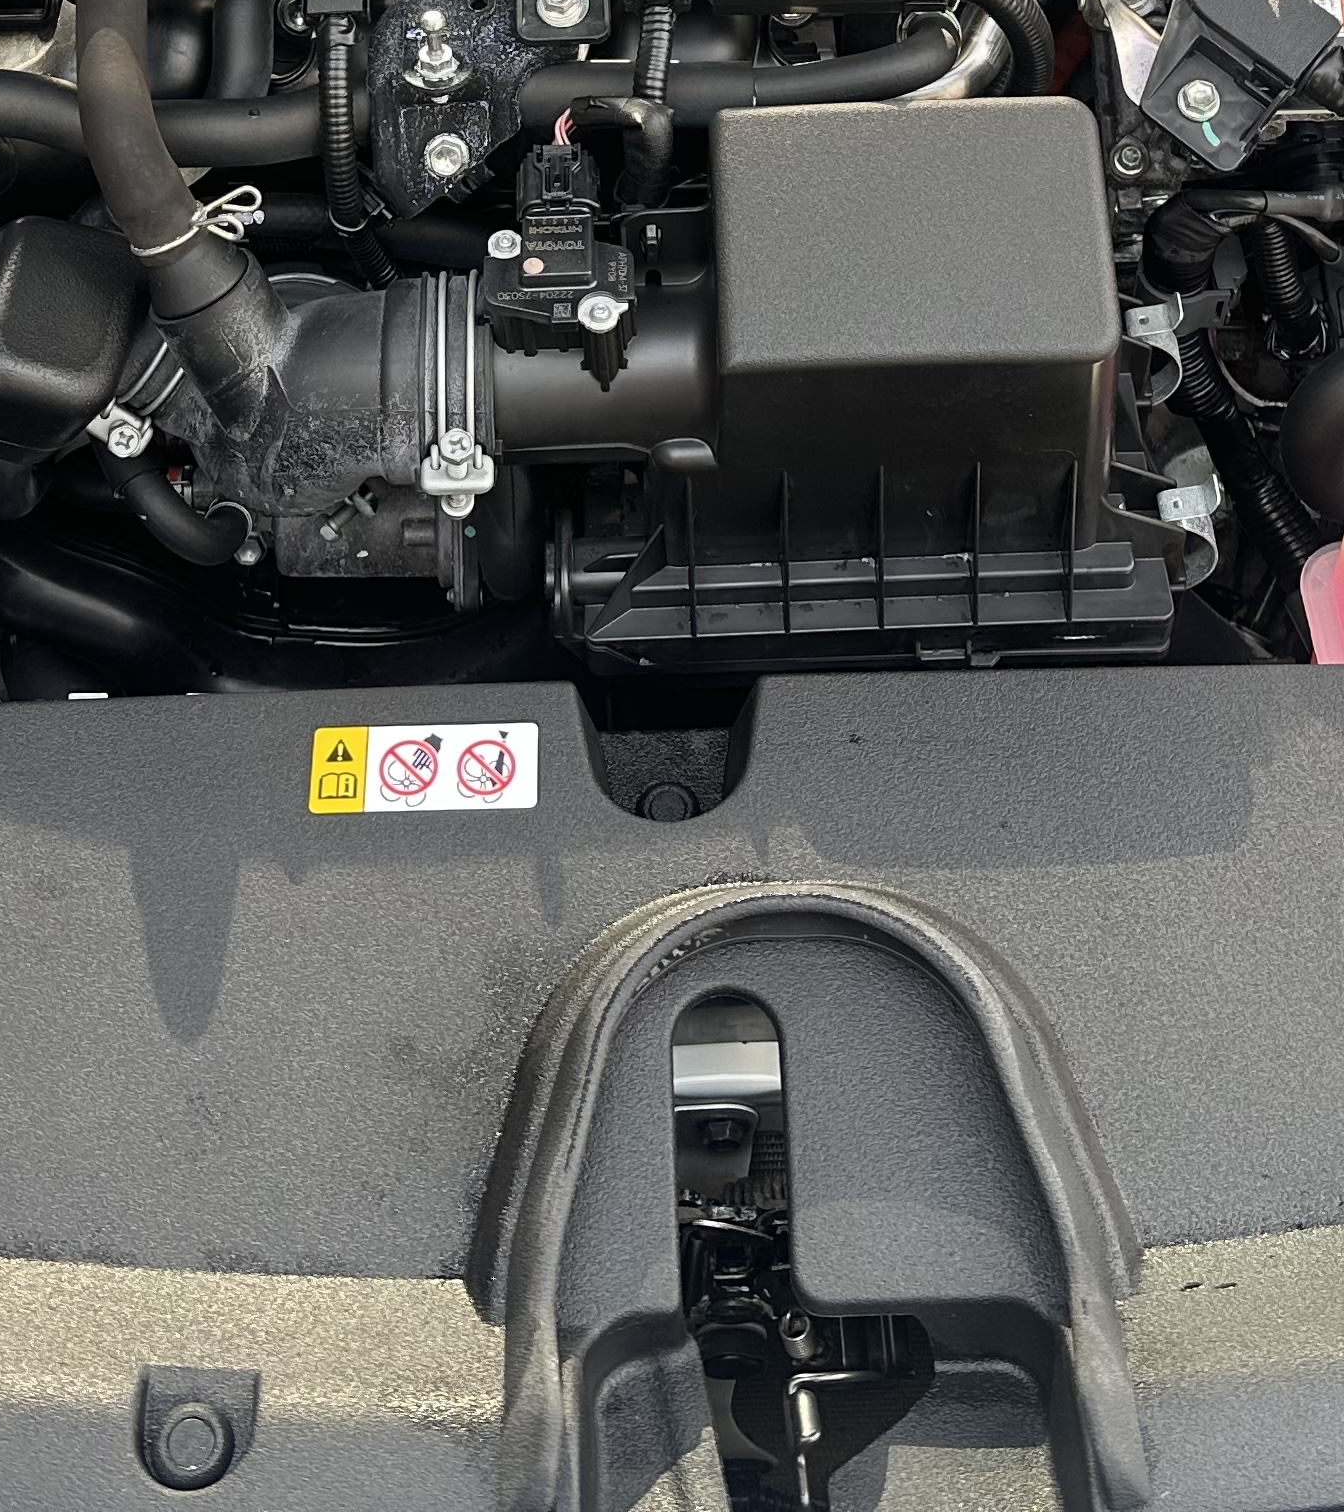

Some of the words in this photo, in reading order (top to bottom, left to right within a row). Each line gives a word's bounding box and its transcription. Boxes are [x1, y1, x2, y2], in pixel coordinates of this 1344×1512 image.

[528, 224, 582, 234] HITACHI
[524, 240, 585, 251] TOYOTA
[497, 290, 575, 300] 22204-75030
